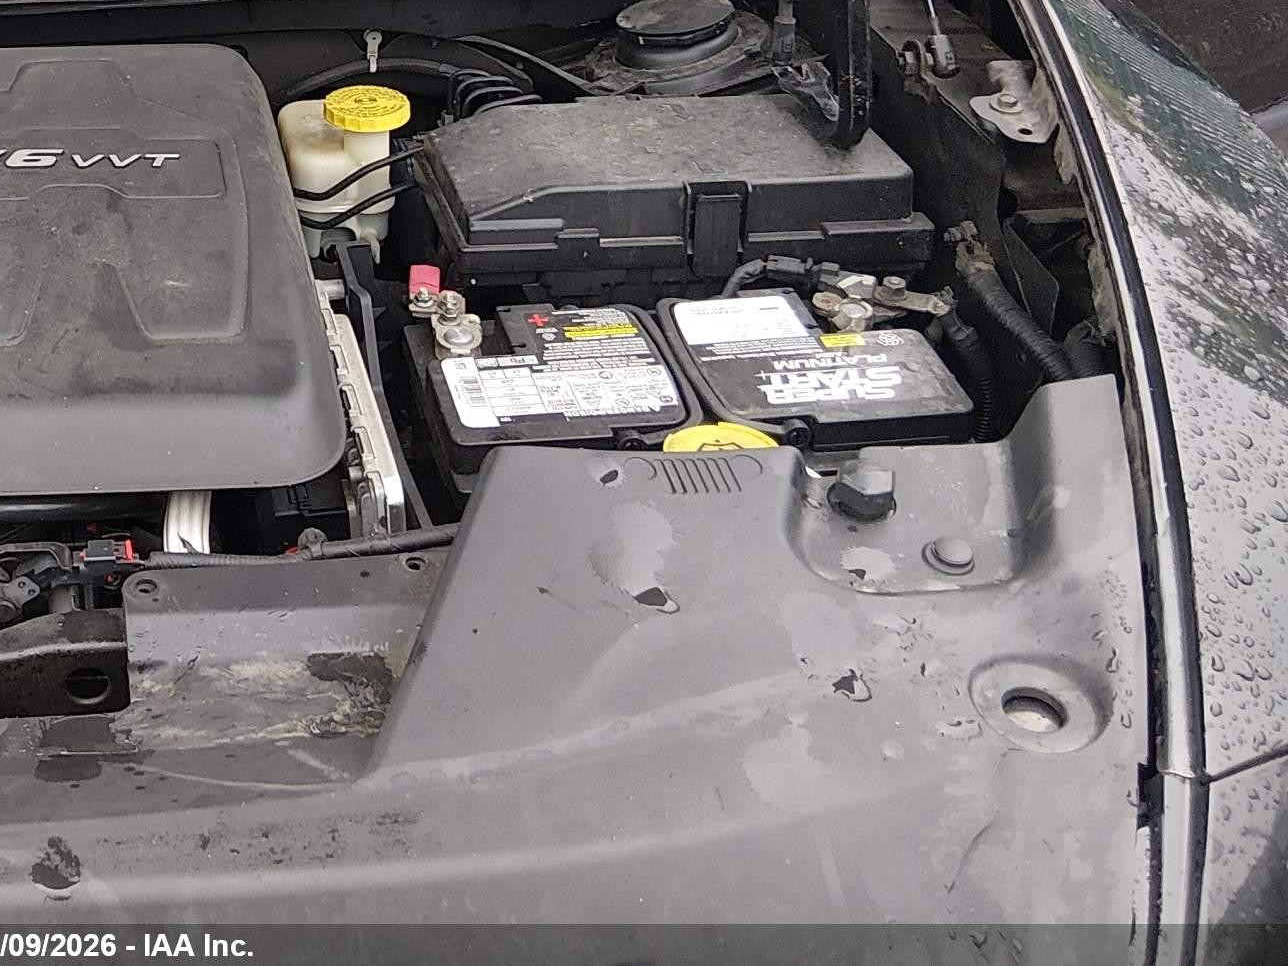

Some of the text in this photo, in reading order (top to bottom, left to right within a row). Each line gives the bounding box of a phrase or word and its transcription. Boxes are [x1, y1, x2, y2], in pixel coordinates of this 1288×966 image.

[71, 152, 181, 169] VVT
[773, 353, 887, 370] PLATINUM
[758, 366, 900, 387] START
[768, 385, 895, 404] SUPER
